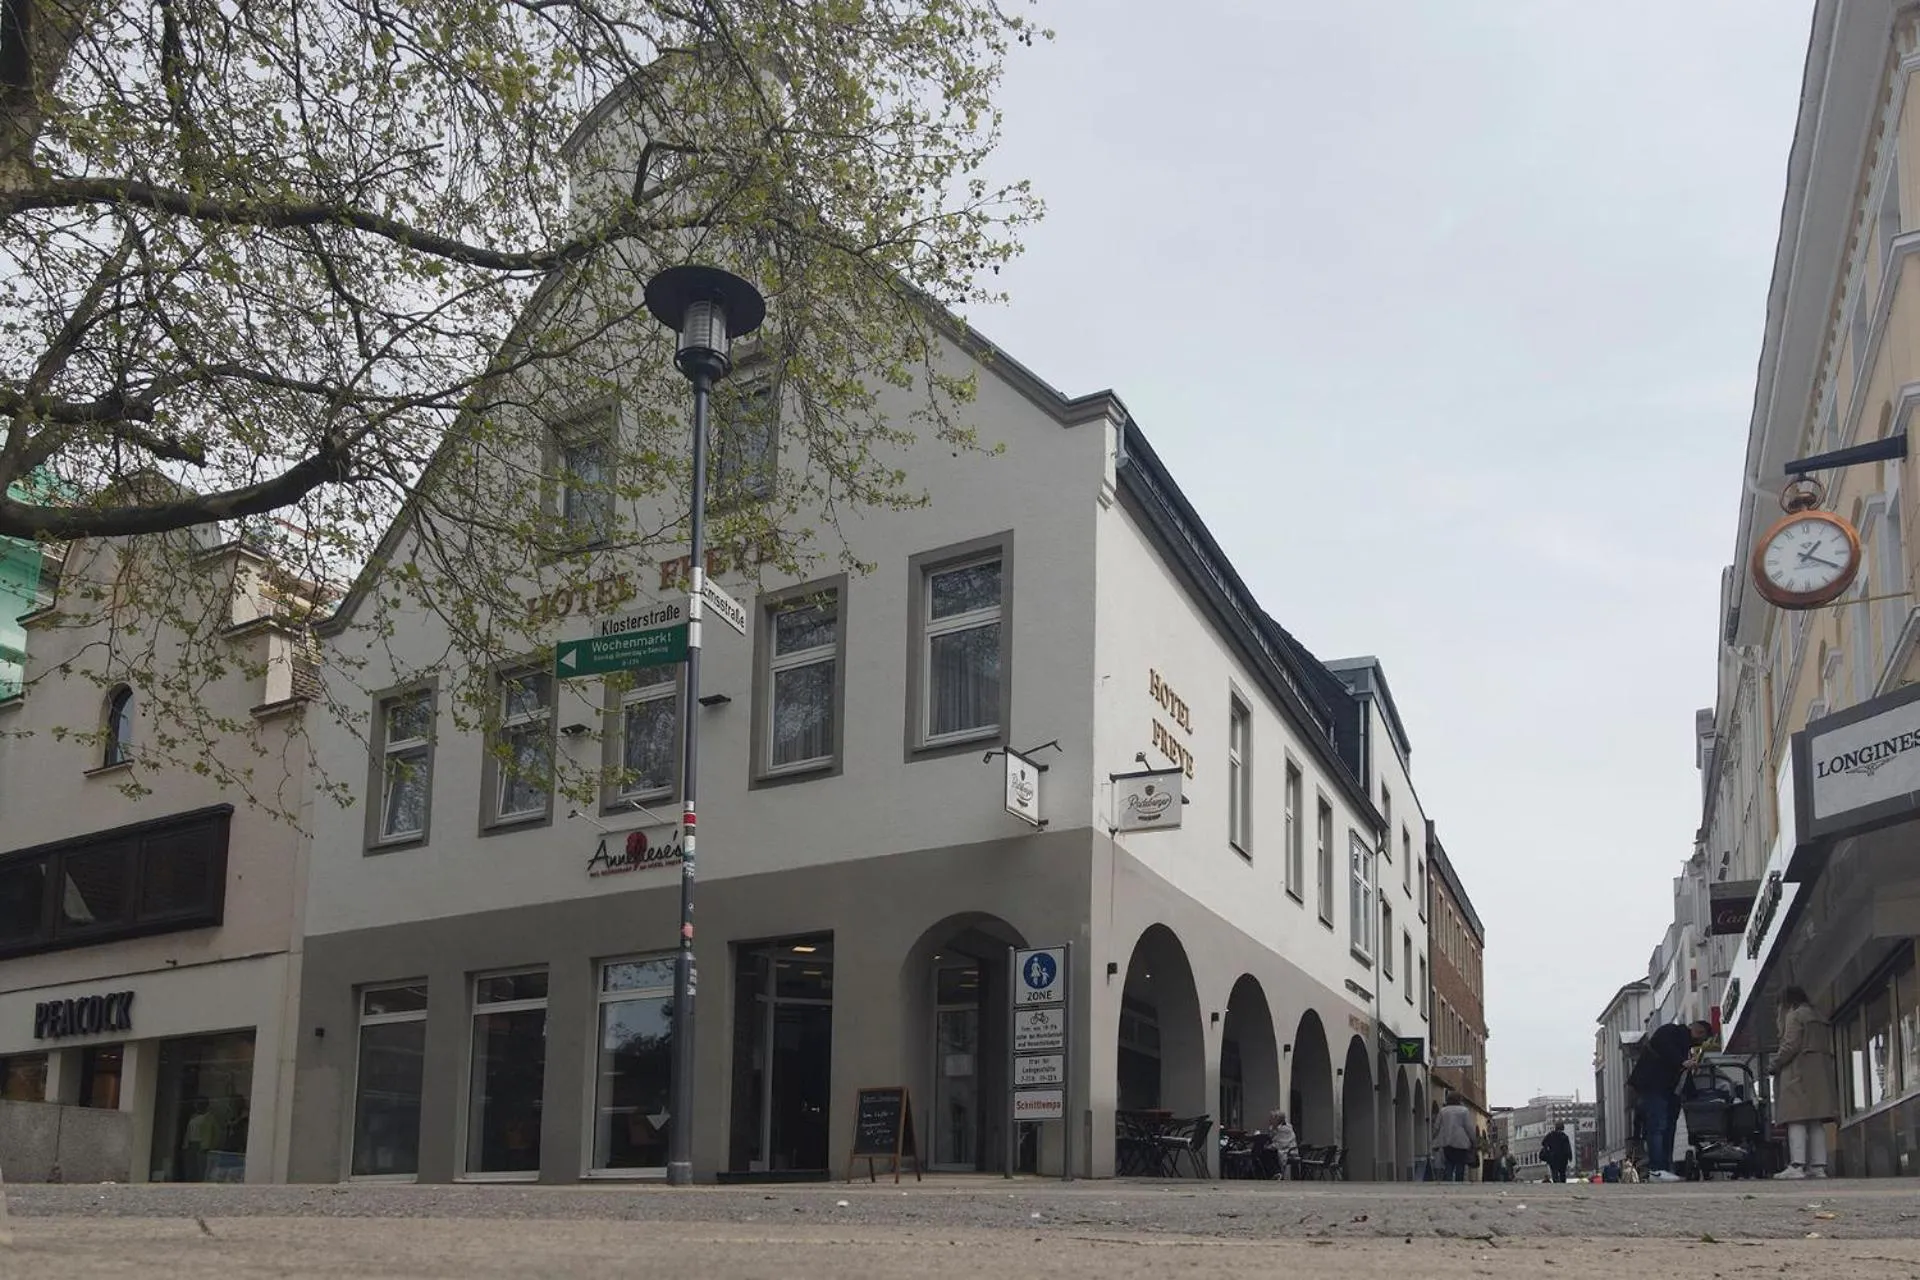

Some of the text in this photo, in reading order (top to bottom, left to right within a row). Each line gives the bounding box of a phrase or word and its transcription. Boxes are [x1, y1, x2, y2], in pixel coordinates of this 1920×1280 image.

[601, 604, 681, 636] Klosterstraße
[591, 631, 672, 653] Wochenmarkt
[1149, 667, 1193, 735] HOTEL
[1817, 727, 1920, 779] LONGINES
[34, 991, 134, 1039] PEACOCK
[1026, 990, 1053, 1001] ZONE
